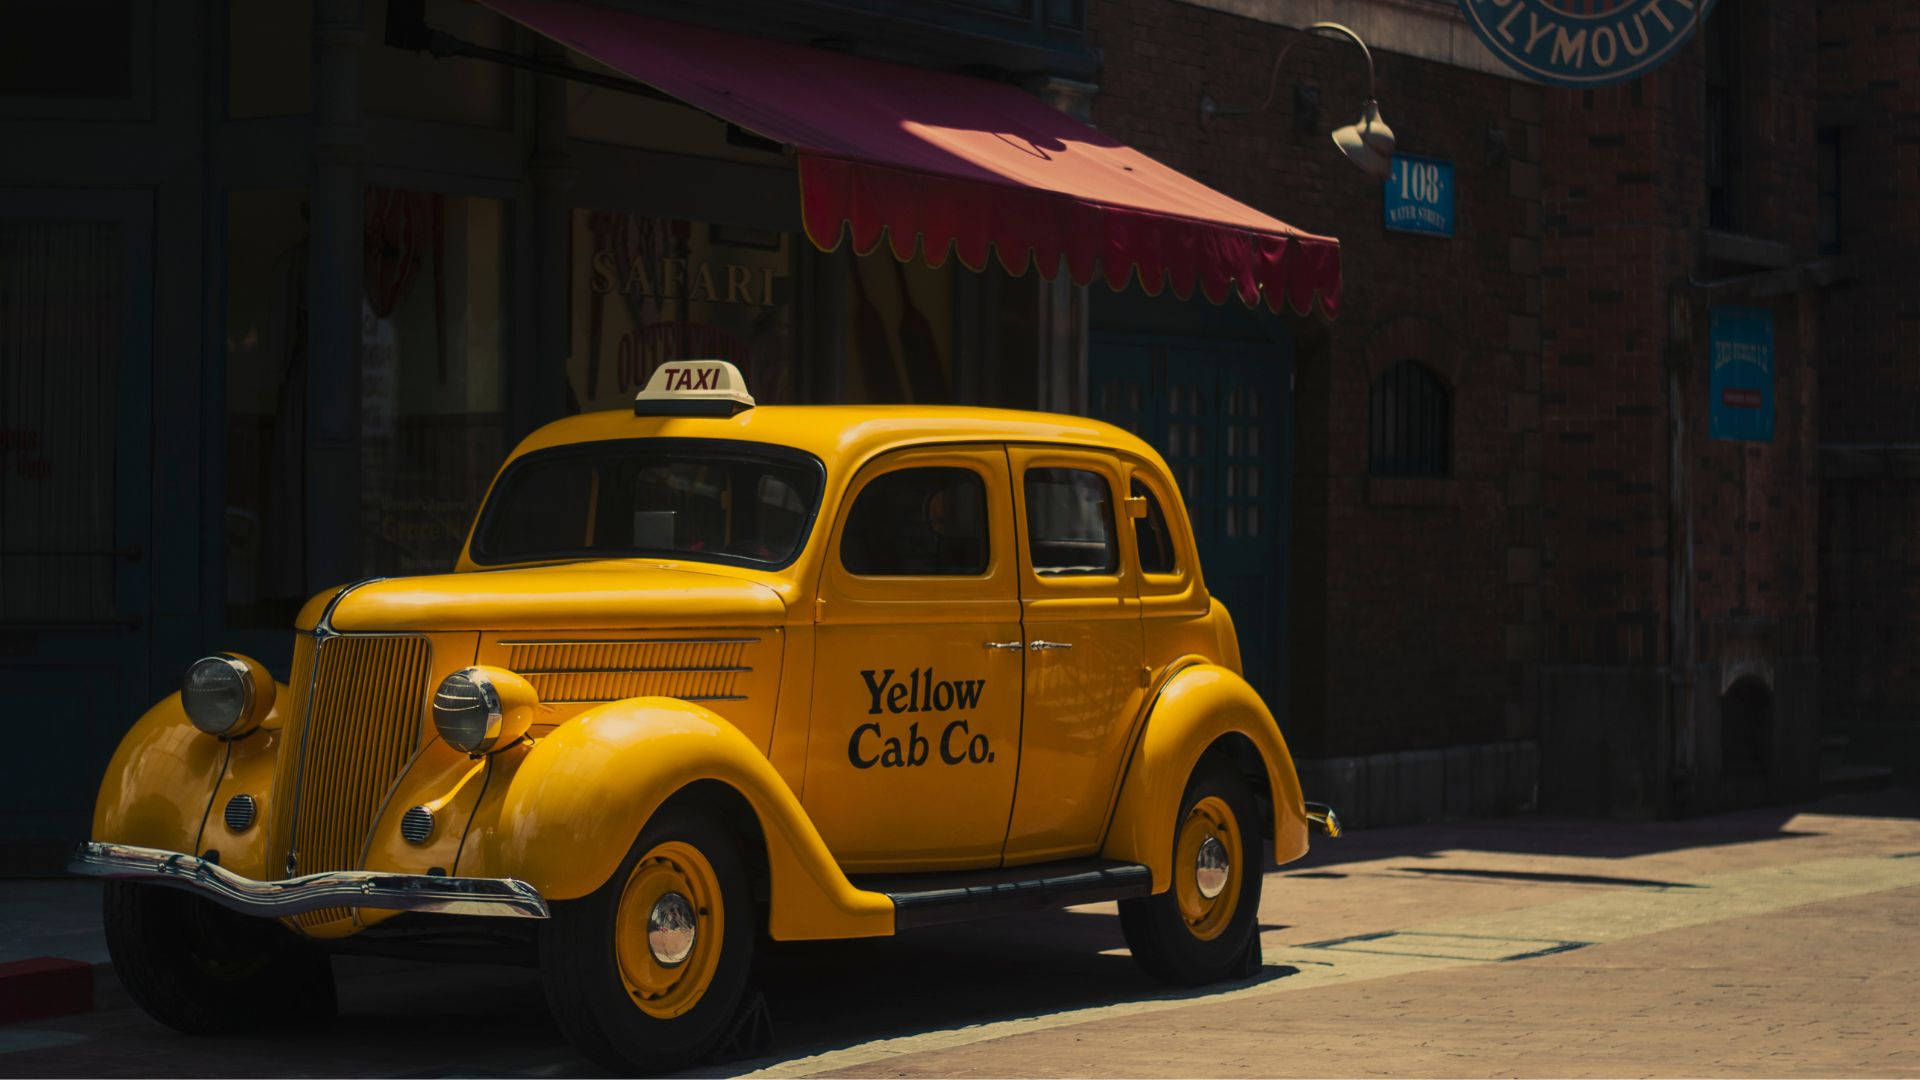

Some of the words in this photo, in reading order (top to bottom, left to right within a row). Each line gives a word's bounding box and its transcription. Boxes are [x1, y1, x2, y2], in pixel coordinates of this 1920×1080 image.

[1476, 0, 1694, 68] LYMOUT
[1401, 160, 1439, 205] 108
[591, 250, 777, 307] SAFARI
[664, 368, 720, 391] TAXI
[860, 667, 986, 714] Yellow
[848, 721, 929, 769] Cab
[939, 719, 995, 765] Co.
